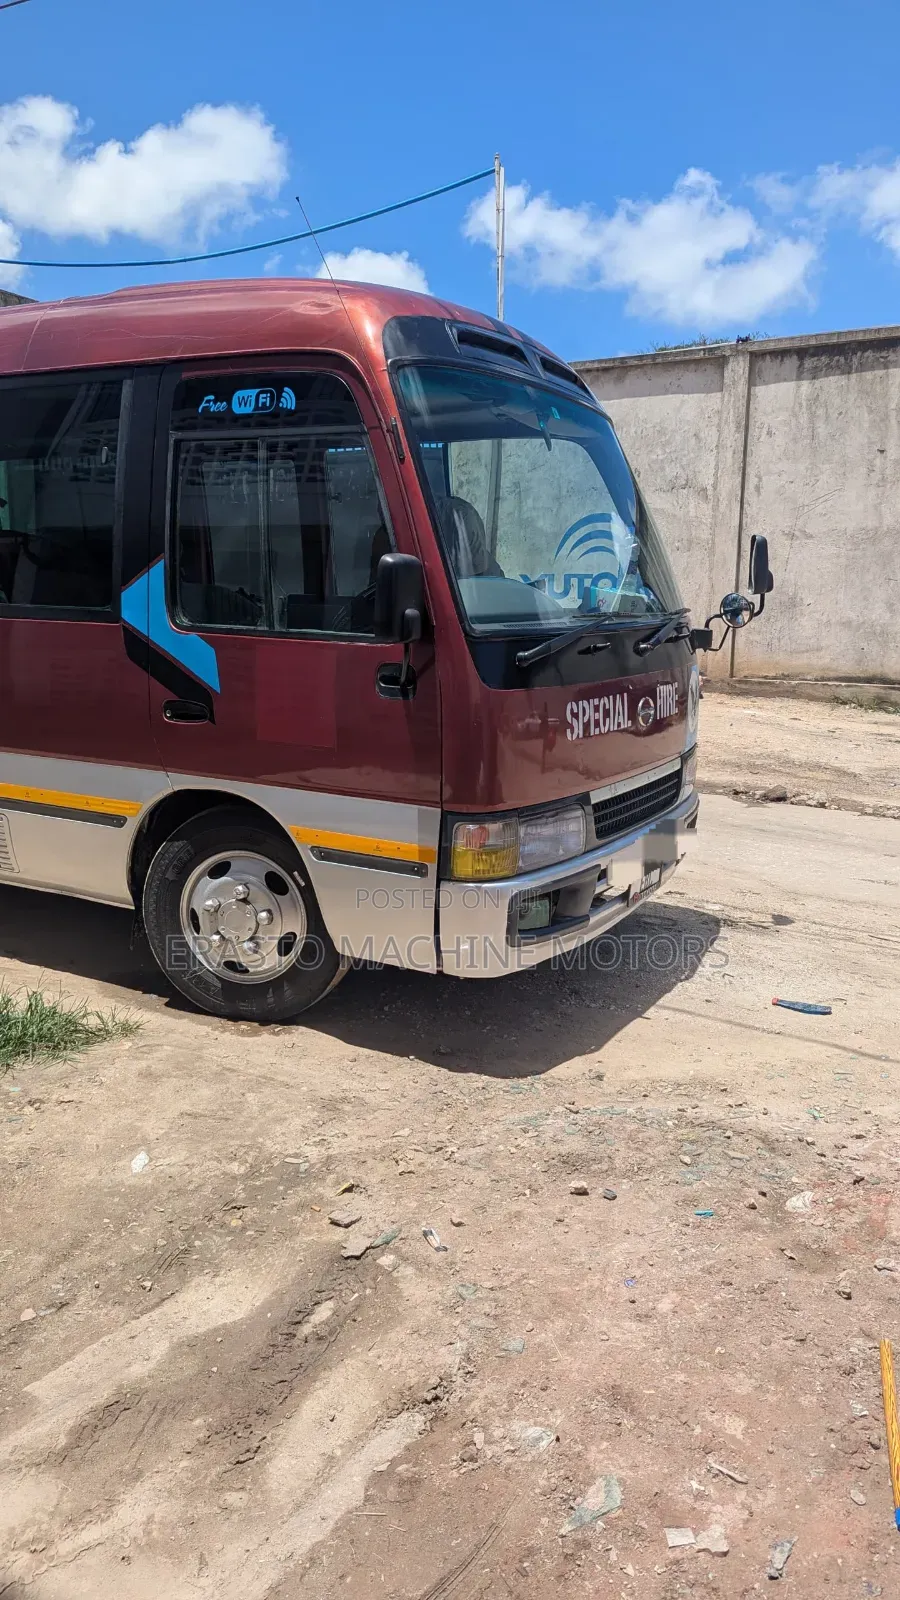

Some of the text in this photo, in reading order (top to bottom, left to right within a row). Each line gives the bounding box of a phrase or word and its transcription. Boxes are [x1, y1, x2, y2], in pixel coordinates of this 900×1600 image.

[198, 395, 228, 413] Free
[565, 681, 679, 741] SPECIAL HIRE
